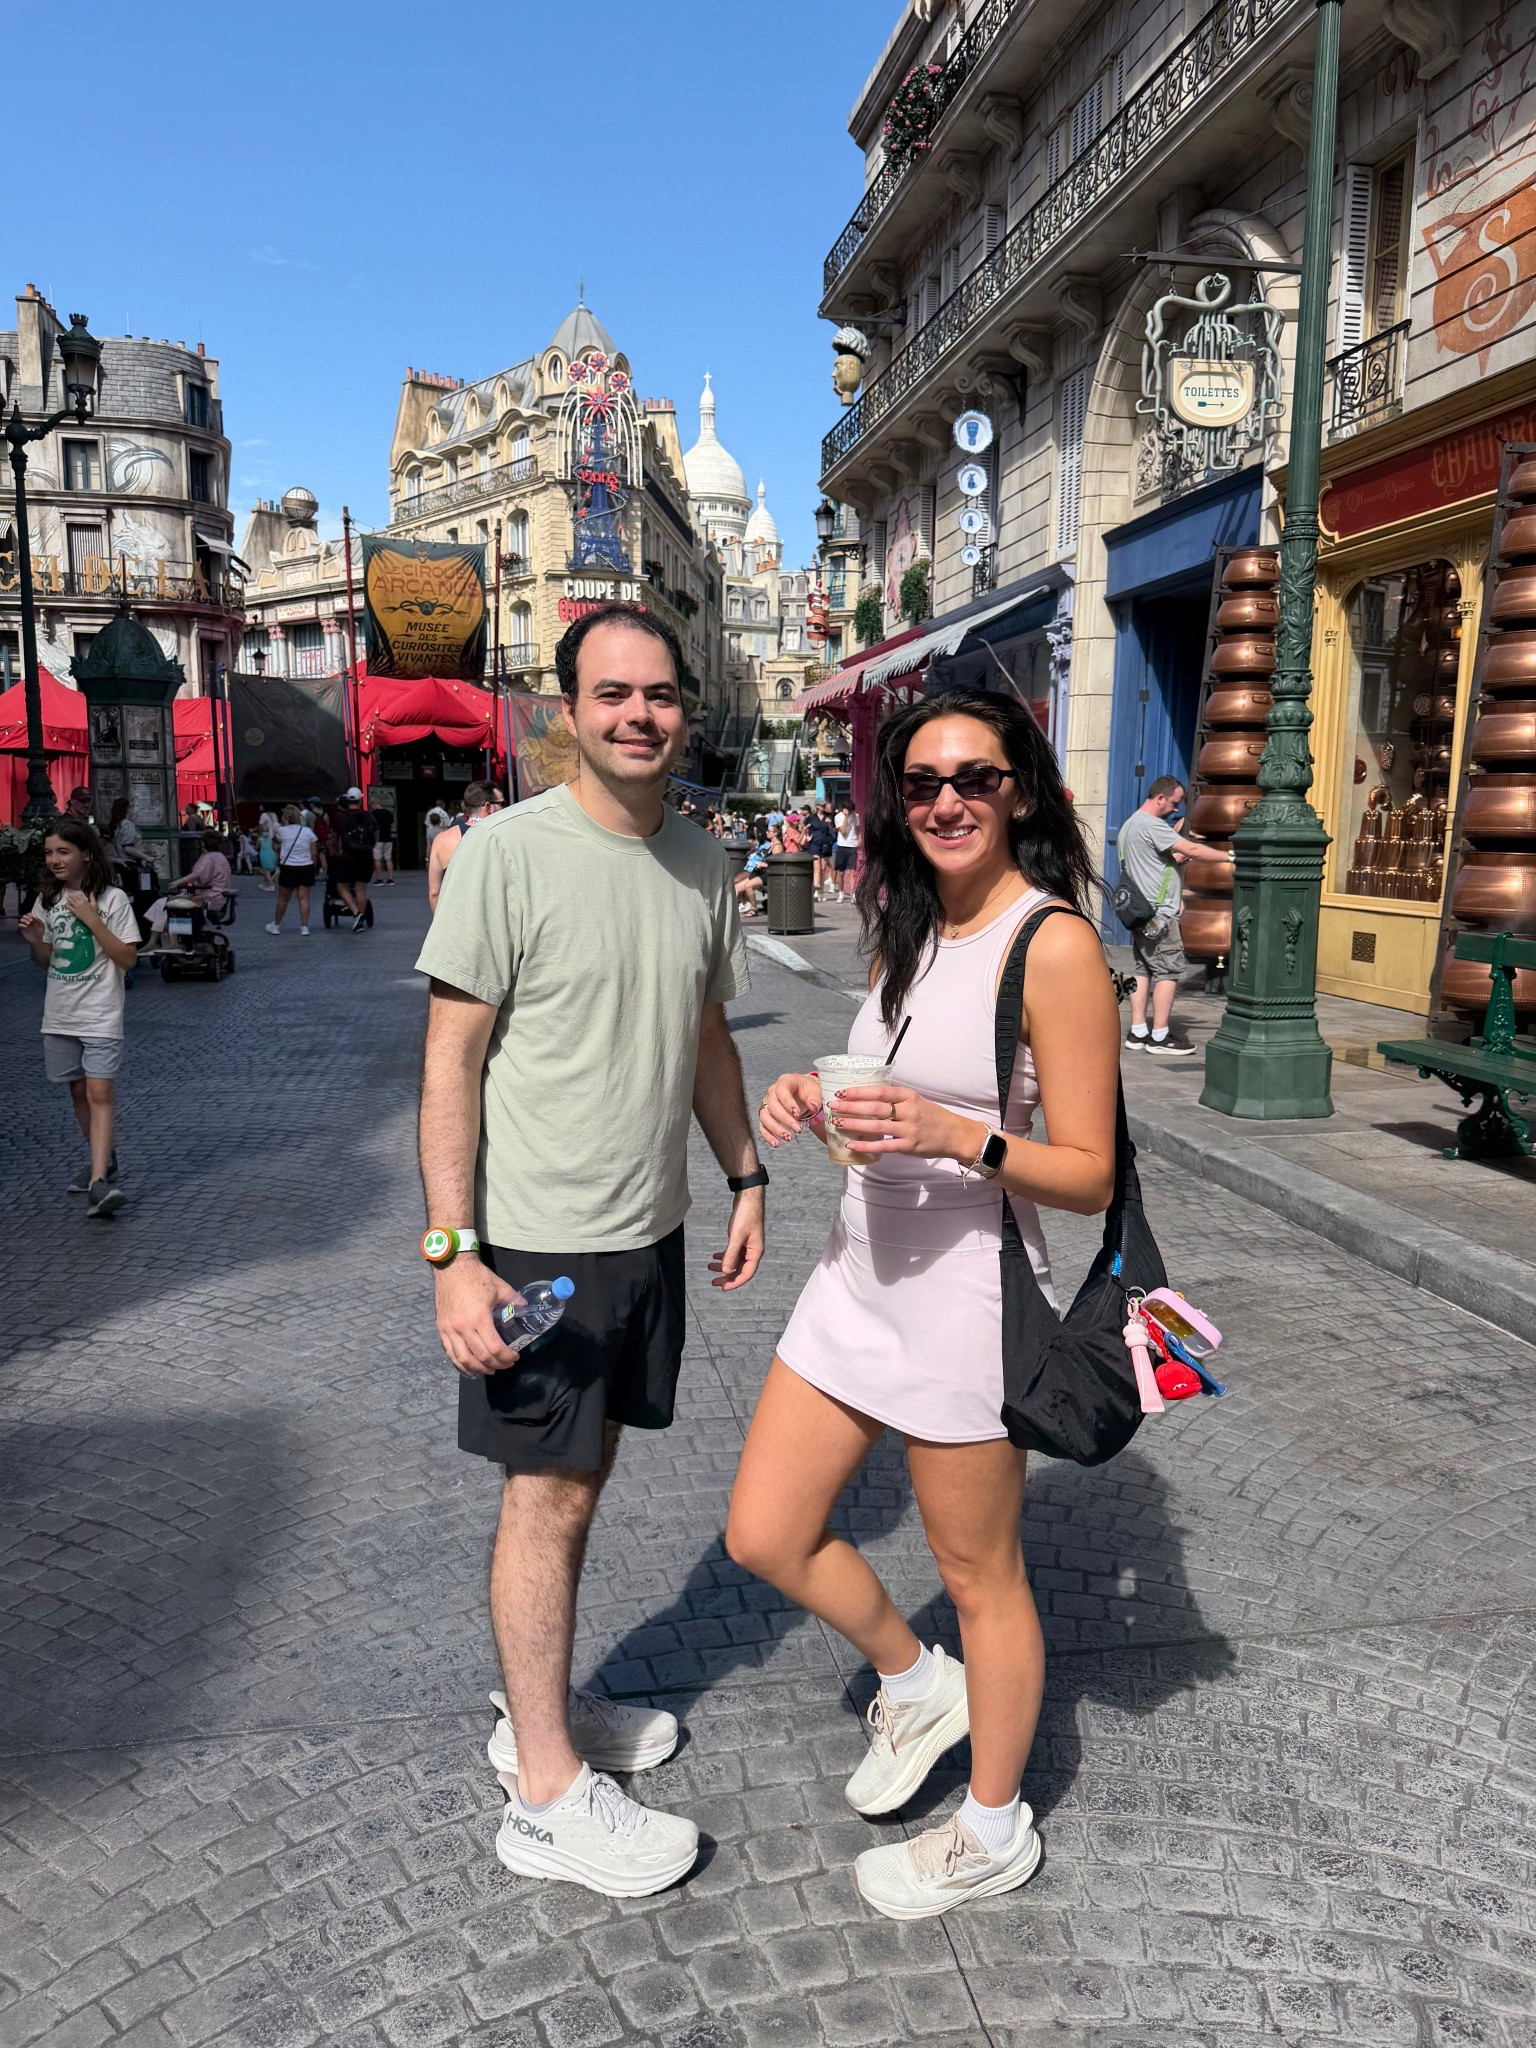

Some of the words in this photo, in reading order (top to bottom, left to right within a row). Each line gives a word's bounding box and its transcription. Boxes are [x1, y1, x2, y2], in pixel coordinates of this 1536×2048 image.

[1184, 386, 1240, 398] TOILETTES
[581, 470, 619, 485] PARIS
[384, 564, 401, 576] LE
[402, 564, 468, 580] CIRQUE
[563, 578, 615, 600] COUPE
[620, 581, 642, 601] DE
[418, 633, 438, 641] DES
[396, 652, 457, 665] VIVANTES
[996, 1015, 1016, 1103] AGGU
[506, 1810, 555, 1846] HOKA
